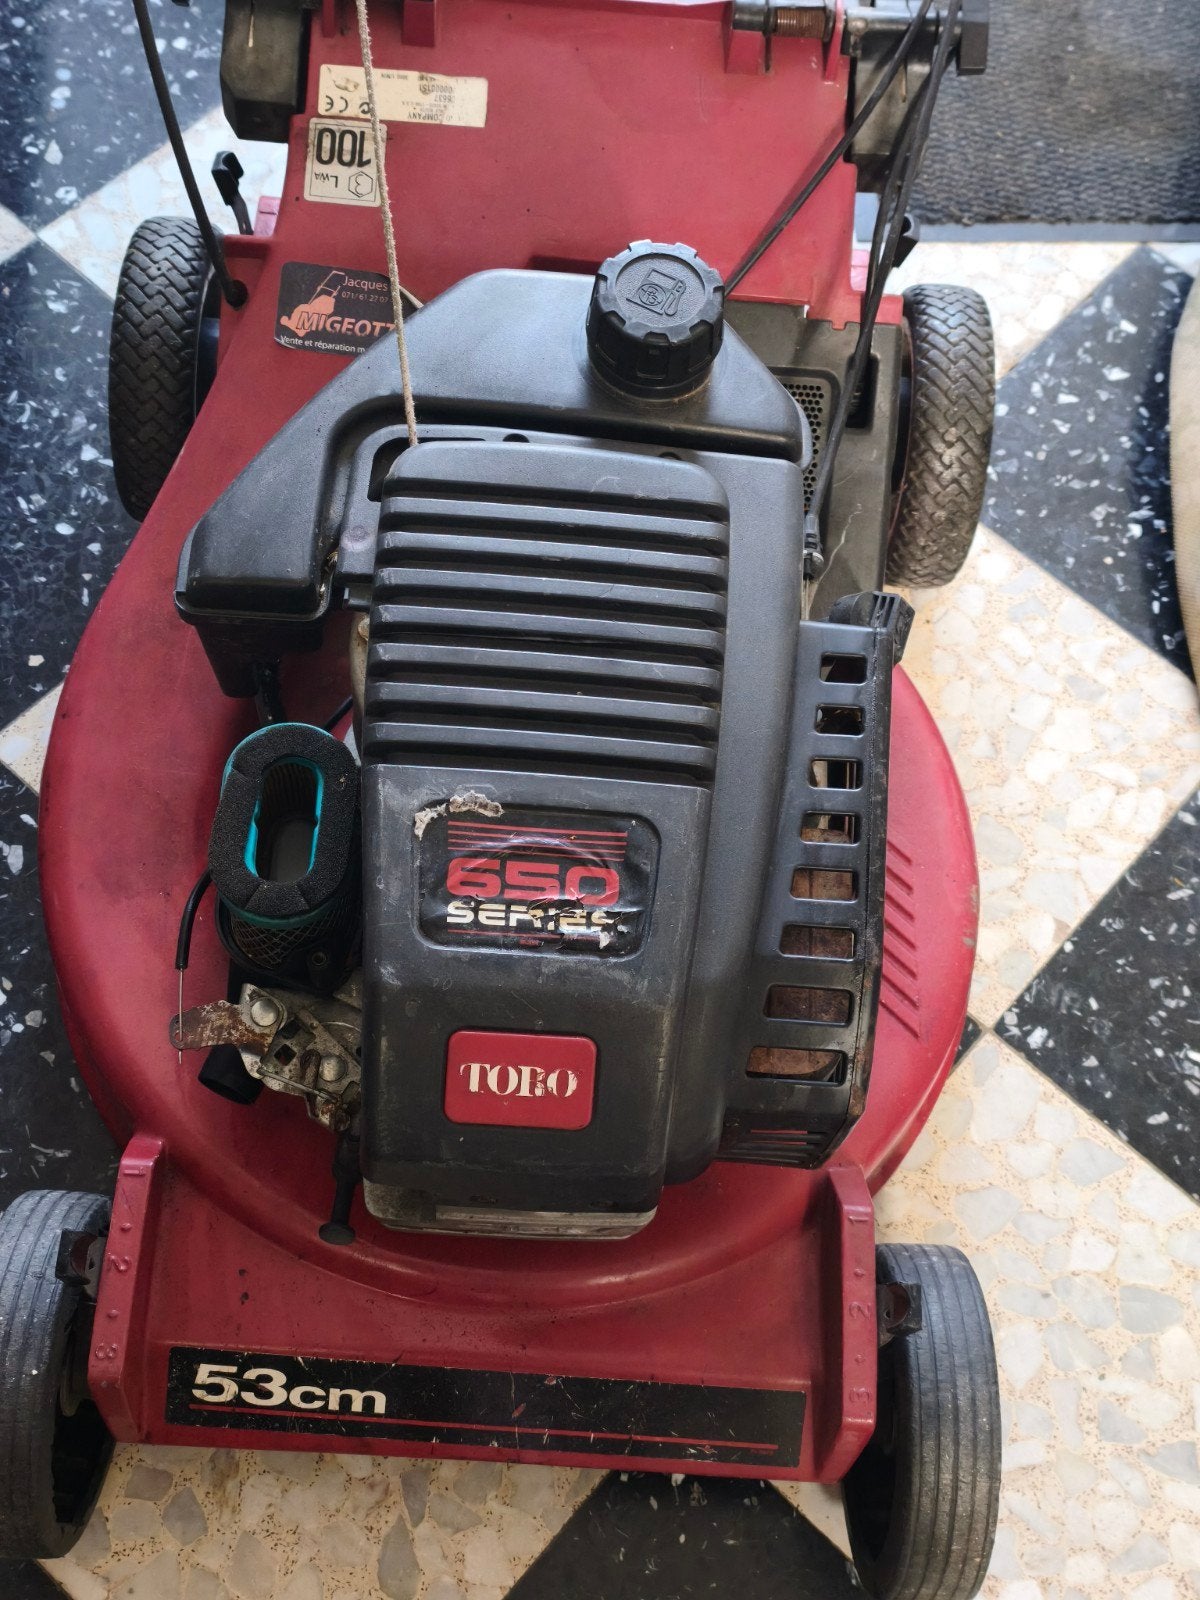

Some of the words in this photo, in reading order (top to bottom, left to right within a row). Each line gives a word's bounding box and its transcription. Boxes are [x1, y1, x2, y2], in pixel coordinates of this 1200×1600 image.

[315, 127, 372, 168] 100
[341, 275, 389, 292] Jacques
[281, 336, 303, 347] Vente
[314, 341, 356, 353] réparation
[446, 857, 620, 906] 650
[459, 1062, 578, 1098] TORO
[191, 1363, 387, 1415] 53cm
